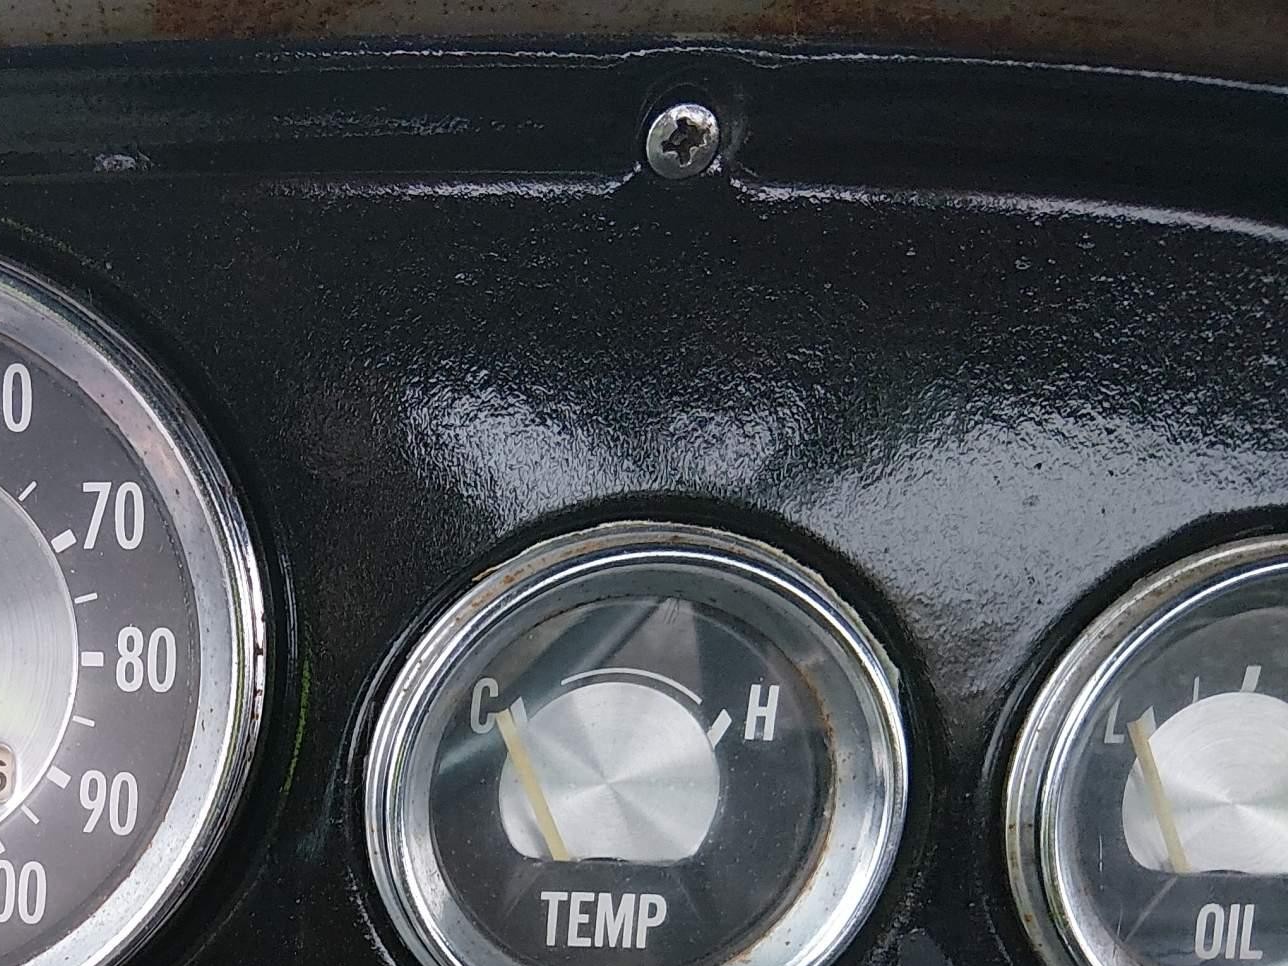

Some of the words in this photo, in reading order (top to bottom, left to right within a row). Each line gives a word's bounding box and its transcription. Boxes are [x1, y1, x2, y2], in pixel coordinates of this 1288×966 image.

[82, 482, 144, 550] 70
[116, 627, 177, 692] 80
[471, 677, 499, 734] C
[744, 684, 780, 742] H
[1104, 698, 1125, 744] L
[79, 772, 138, 836] 90
[541, 891, 668, 950] TEMP
[1194, 903, 1264, 961] OIL
